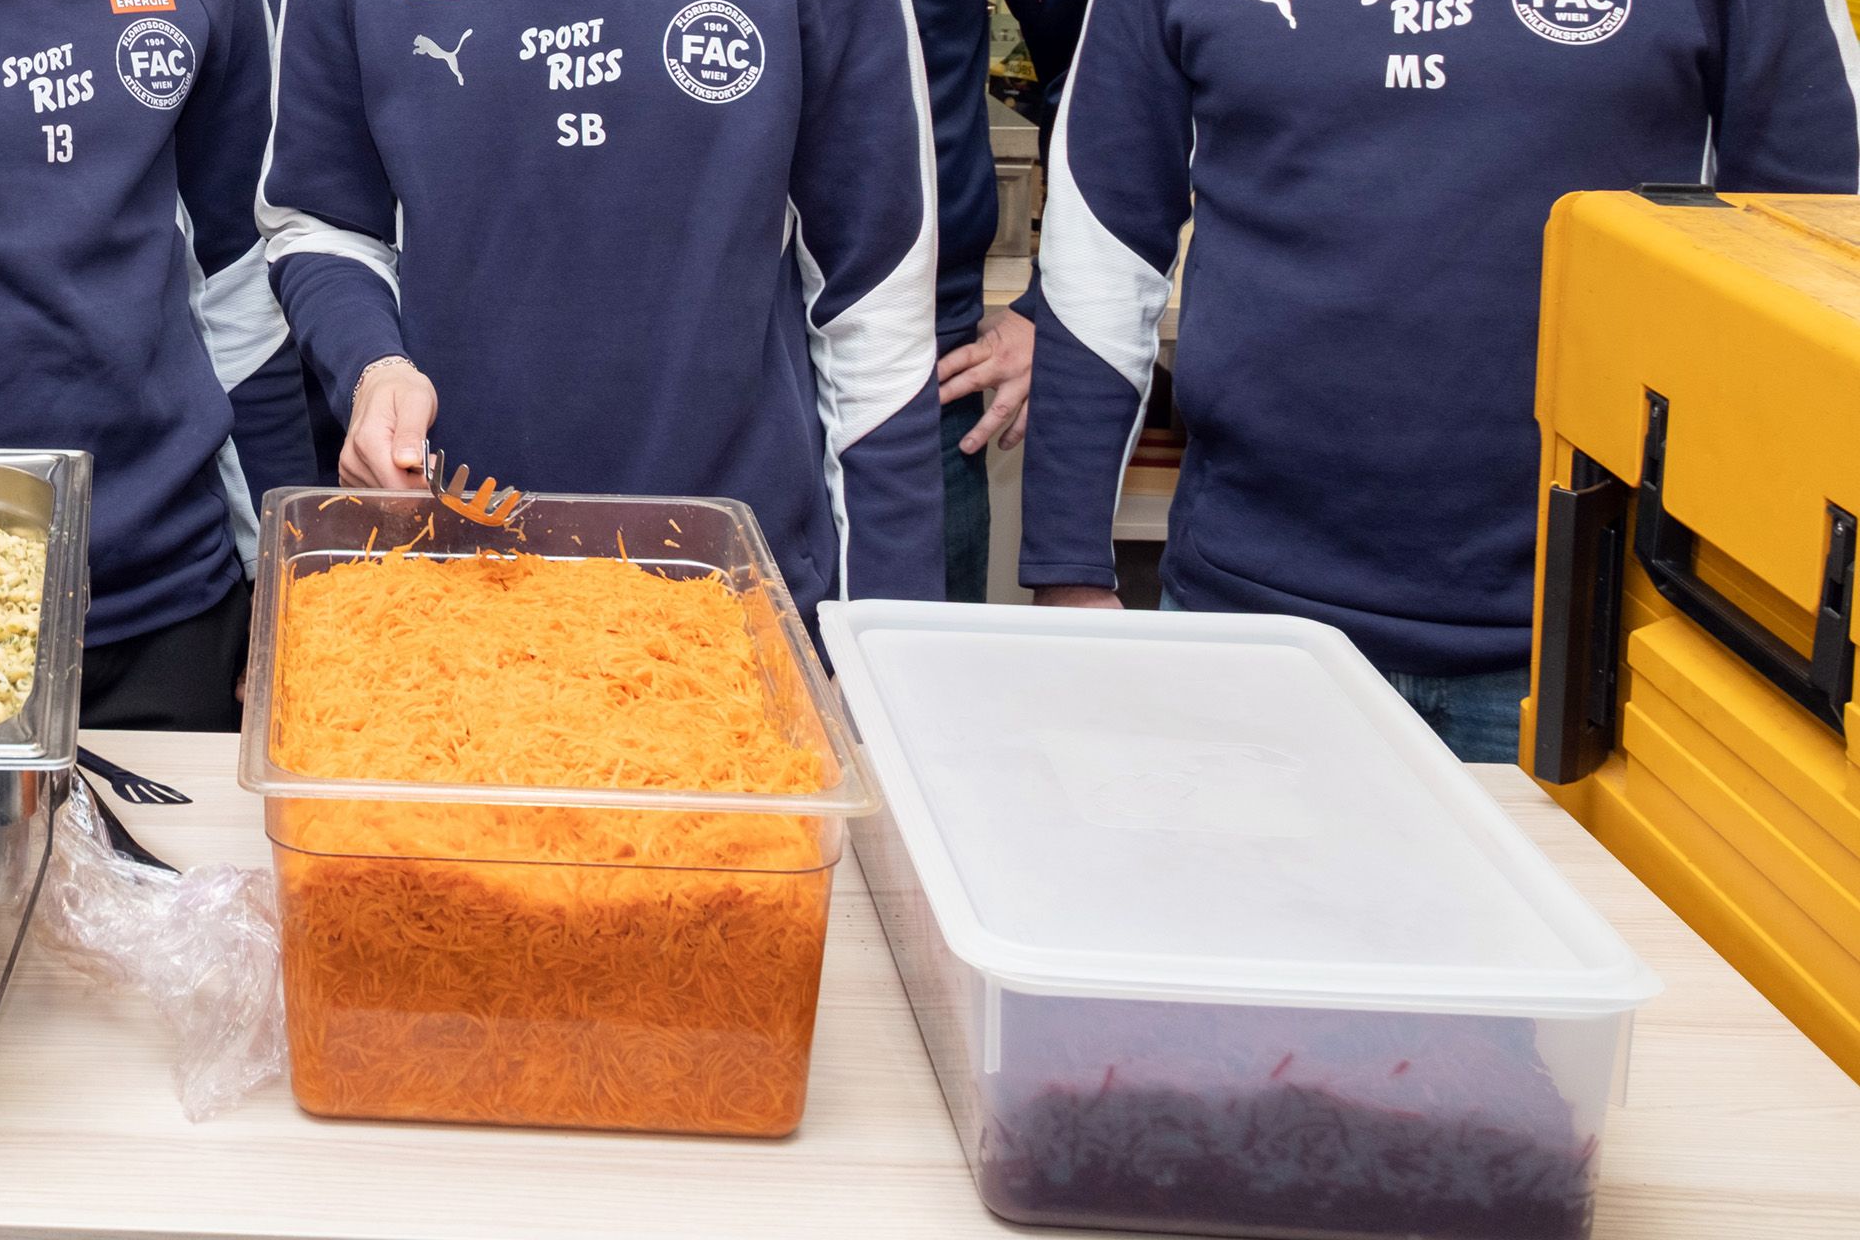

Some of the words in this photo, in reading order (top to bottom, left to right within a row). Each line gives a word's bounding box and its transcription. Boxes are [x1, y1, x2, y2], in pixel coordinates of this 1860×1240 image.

[122, 21, 185, 47] FLORIDSDORFER
[675, 3, 754, 36] FLORIDSDORFER
[703, 22, 728, 33] 1904
[1555, 12, 1589, 22] WIEN
[145, 38, 165, 46] 1904
[519, 18, 604, 61] SPORT
[681, 34, 750, 70] FAC
[2, 43, 73, 88] SPORT
[130, 49, 186, 78] FAC
[547, 49, 623, 91] RISS
[701, 70, 727, 81] WIEN
[1385, 54, 1446, 90] MS
[28, 69, 95, 114] RISS
[151, 81, 173, 89] WIEN
[42, 124, 74, 163] 13
[557, 112, 606, 147] SB
